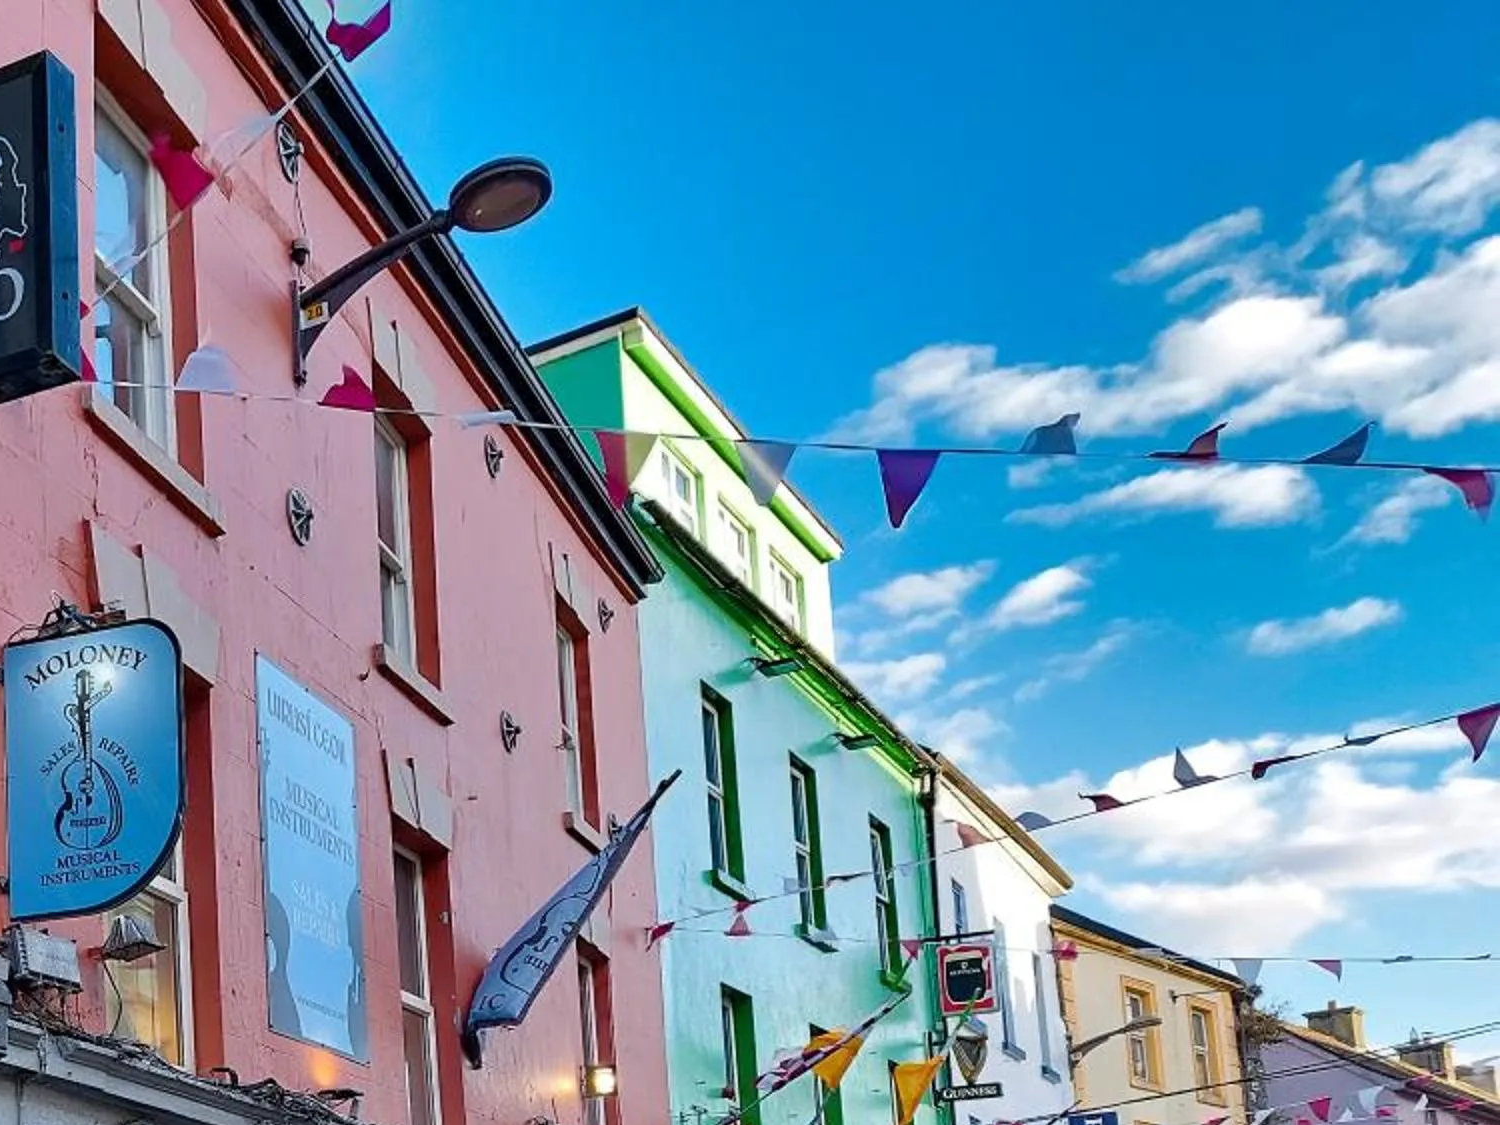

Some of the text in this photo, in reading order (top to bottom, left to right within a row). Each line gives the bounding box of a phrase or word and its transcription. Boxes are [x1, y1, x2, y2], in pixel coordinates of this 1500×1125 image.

[23, 643, 148, 691] MOLONEY
[270, 797, 355, 867] INSTRUMENTS
[57, 850, 122, 869] MUSICAL
[40, 862, 141, 886] INSTRUMENTS
[943, 1085, 997, 1100] GUINNESS
